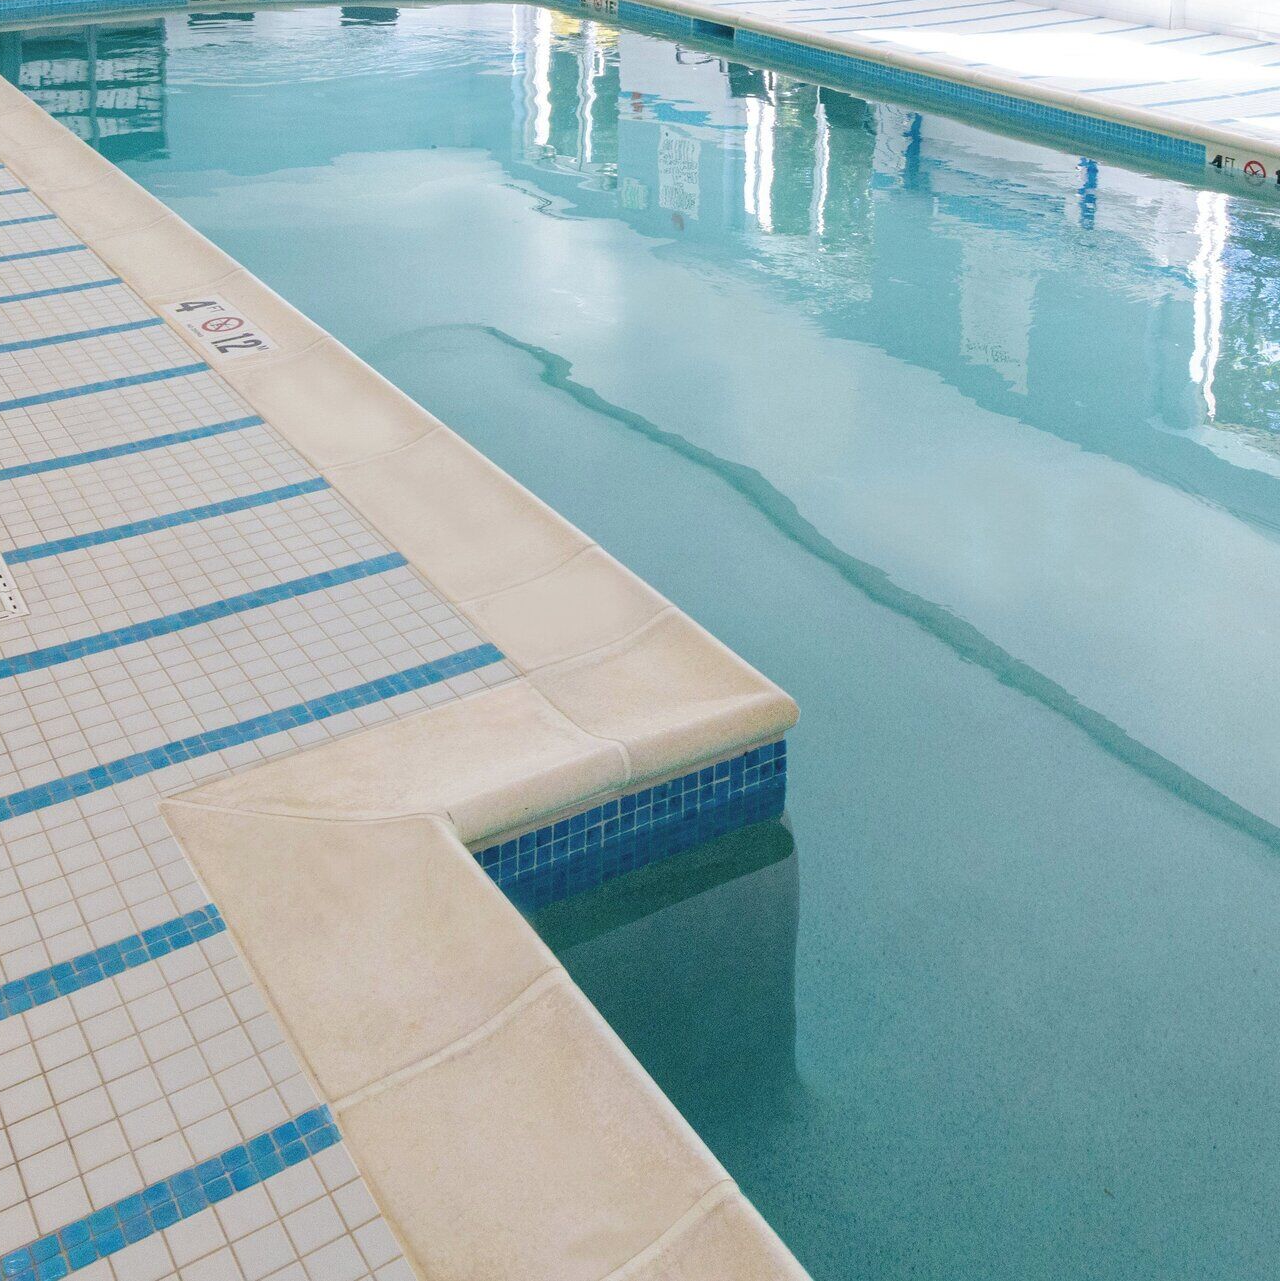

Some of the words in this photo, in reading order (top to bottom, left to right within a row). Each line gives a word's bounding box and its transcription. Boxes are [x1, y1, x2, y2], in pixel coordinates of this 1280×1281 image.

[1209, 154, 1223, 169] 4
[1225, 156, 1236, 168] FT
[176, 301, 217, 313] 4
